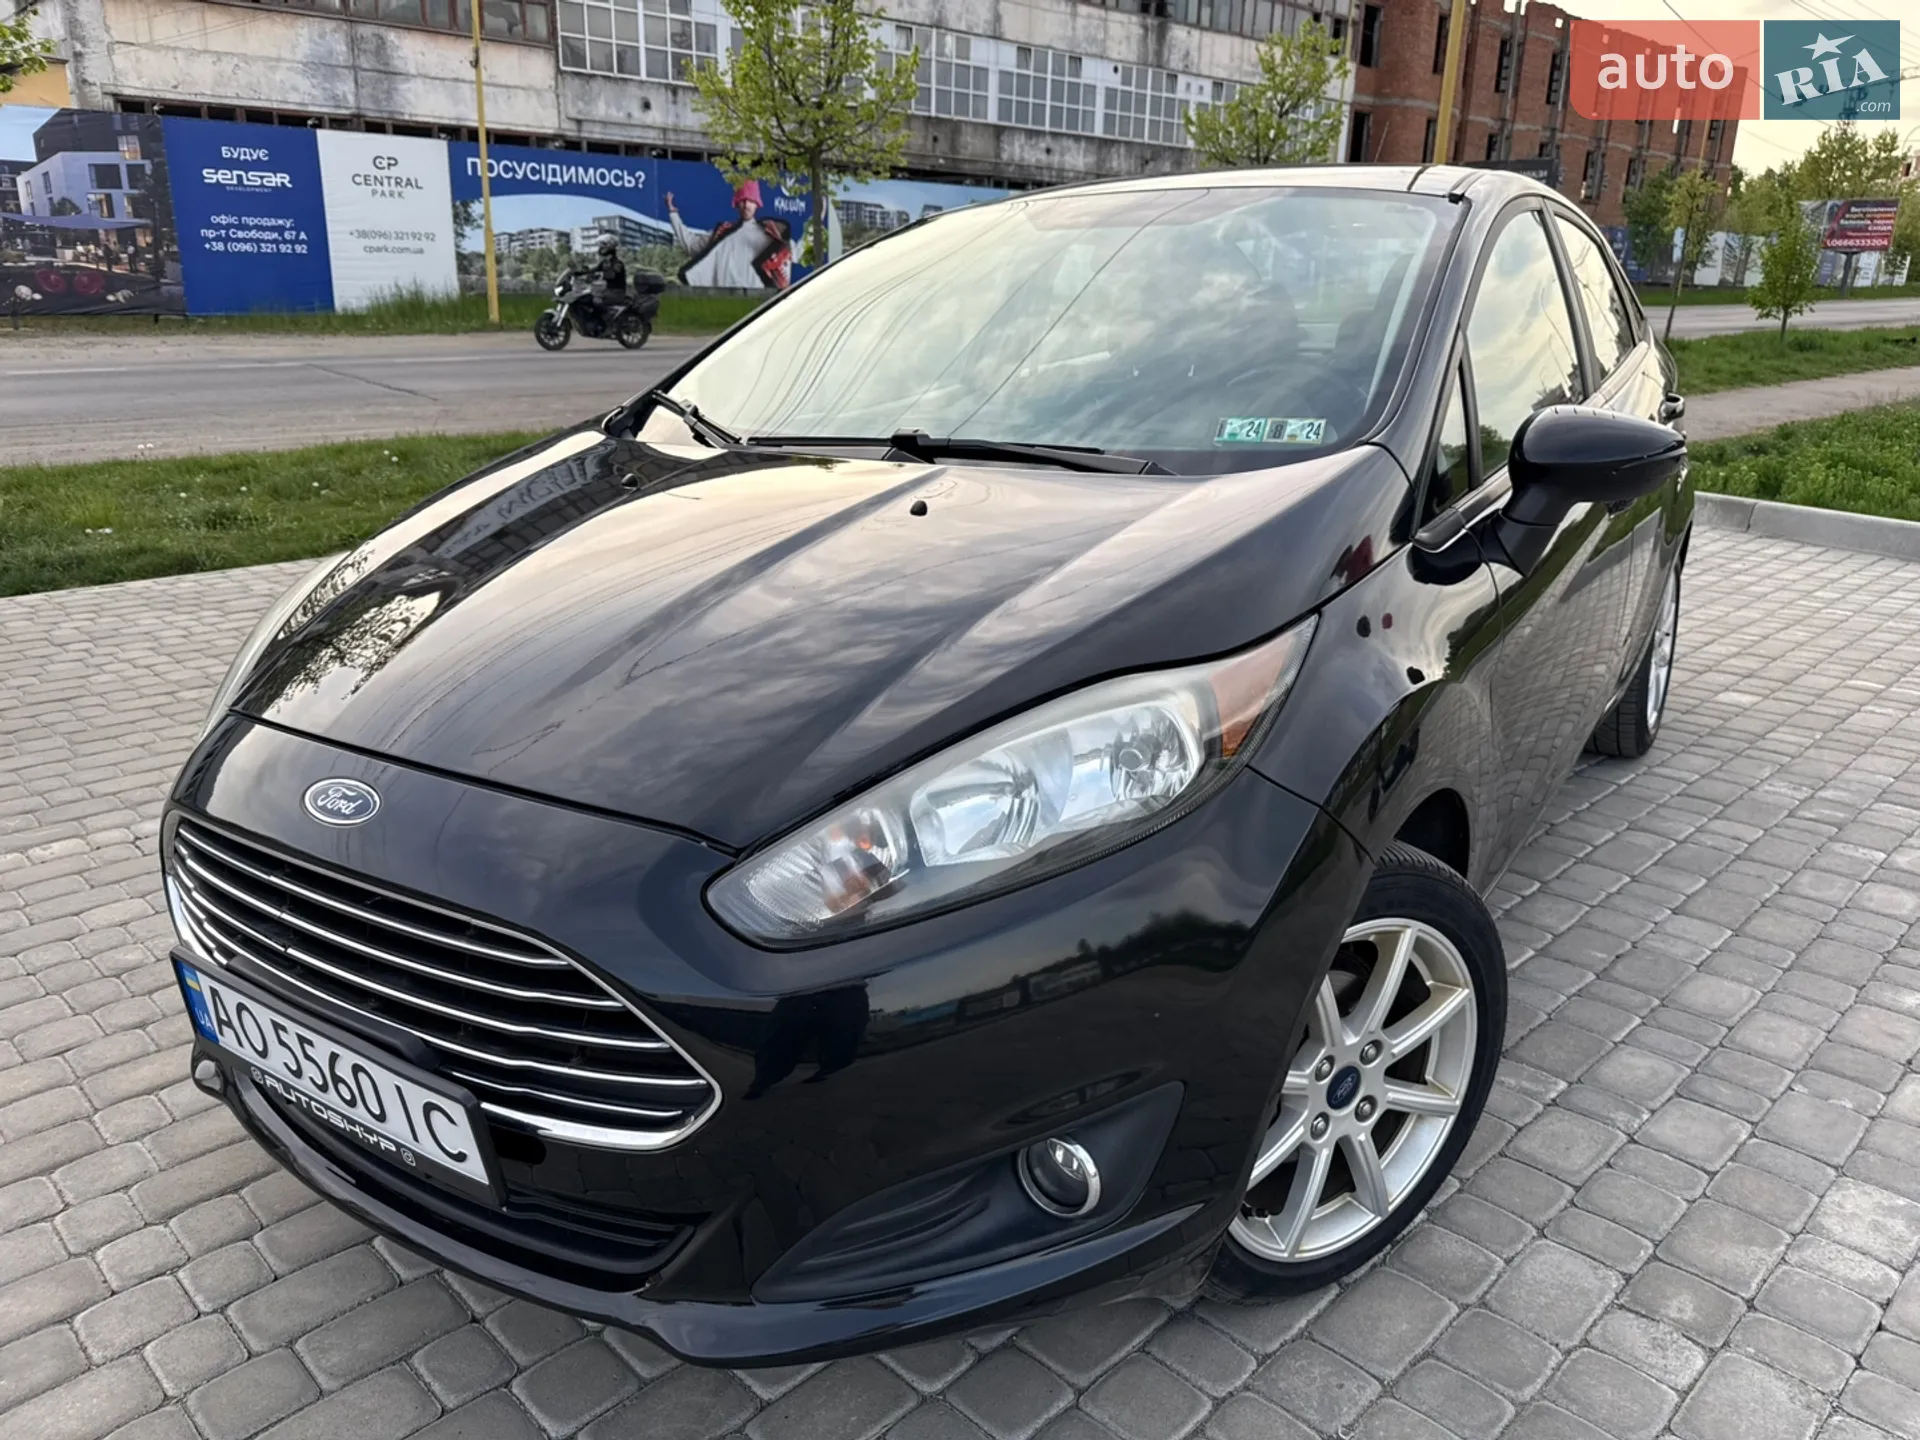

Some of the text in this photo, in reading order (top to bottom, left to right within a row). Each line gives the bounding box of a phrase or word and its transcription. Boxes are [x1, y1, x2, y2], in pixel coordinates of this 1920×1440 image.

[221, 146, 269, 161] БУДУЄ
[466, 157, 646, 189] ПОСУСІДИМОСЬ?
[351, 173, 424, 190] CENTRAL
[371, 188, 405, 200] PARK
[210, 214, 295, 229] офіс продажу:
[228, 228, 282, 241] Свободи,
[283, 230, 296, 241] 67
[204, 241, 308, 255] +38 (096) 321 92 92
[1245, 421, 1262, 438] 24
[1305, 422, 1322, 440] 24
[317, 786, 363, 815] Ford
